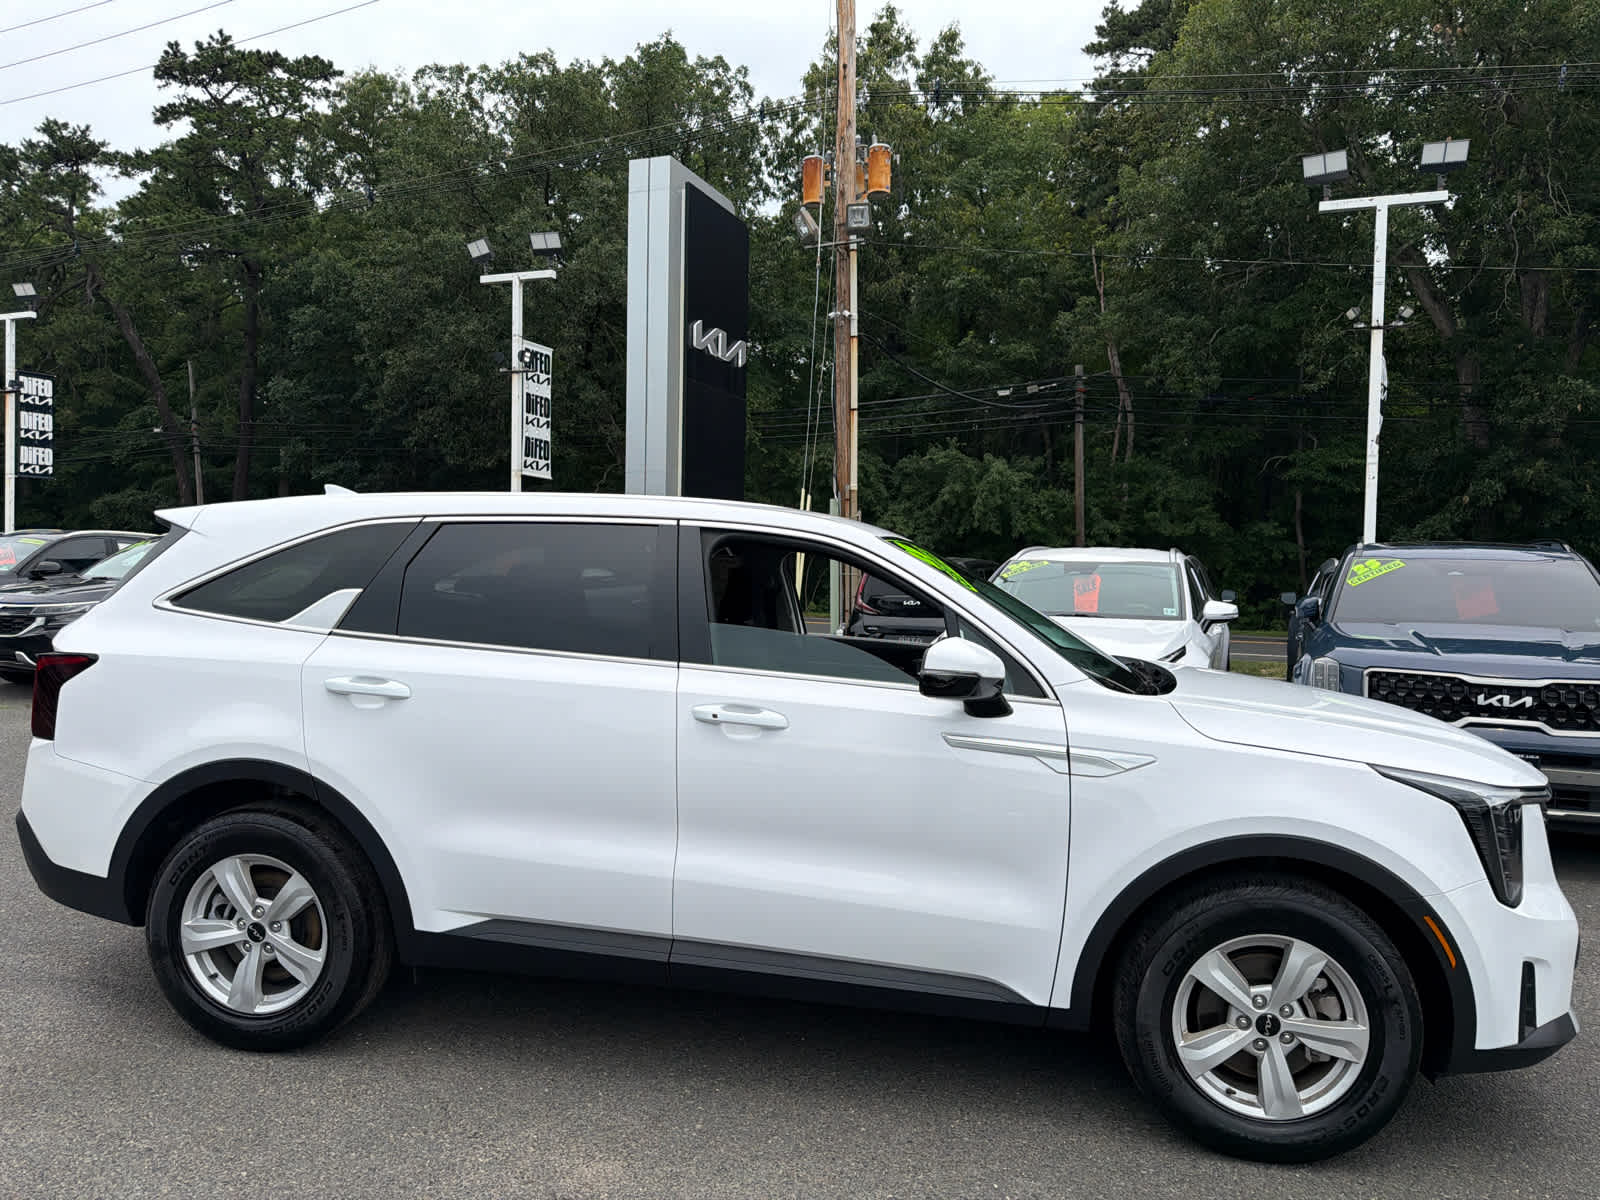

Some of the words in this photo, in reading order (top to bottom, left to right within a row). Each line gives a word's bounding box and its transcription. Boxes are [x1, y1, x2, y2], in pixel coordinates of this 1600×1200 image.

[692, 319, 747, 368] KIA
[525, 371, 551, 386] KIA
[20, 394, 53, 406] KIA
[525, 415, 551, 430] KIA
[20, 429, 53, 441] KIA
[20, 464, 53, 475] KIA
[523, 459, 550, 472] KIA
[1477, 693, 1533, 708] KIA
